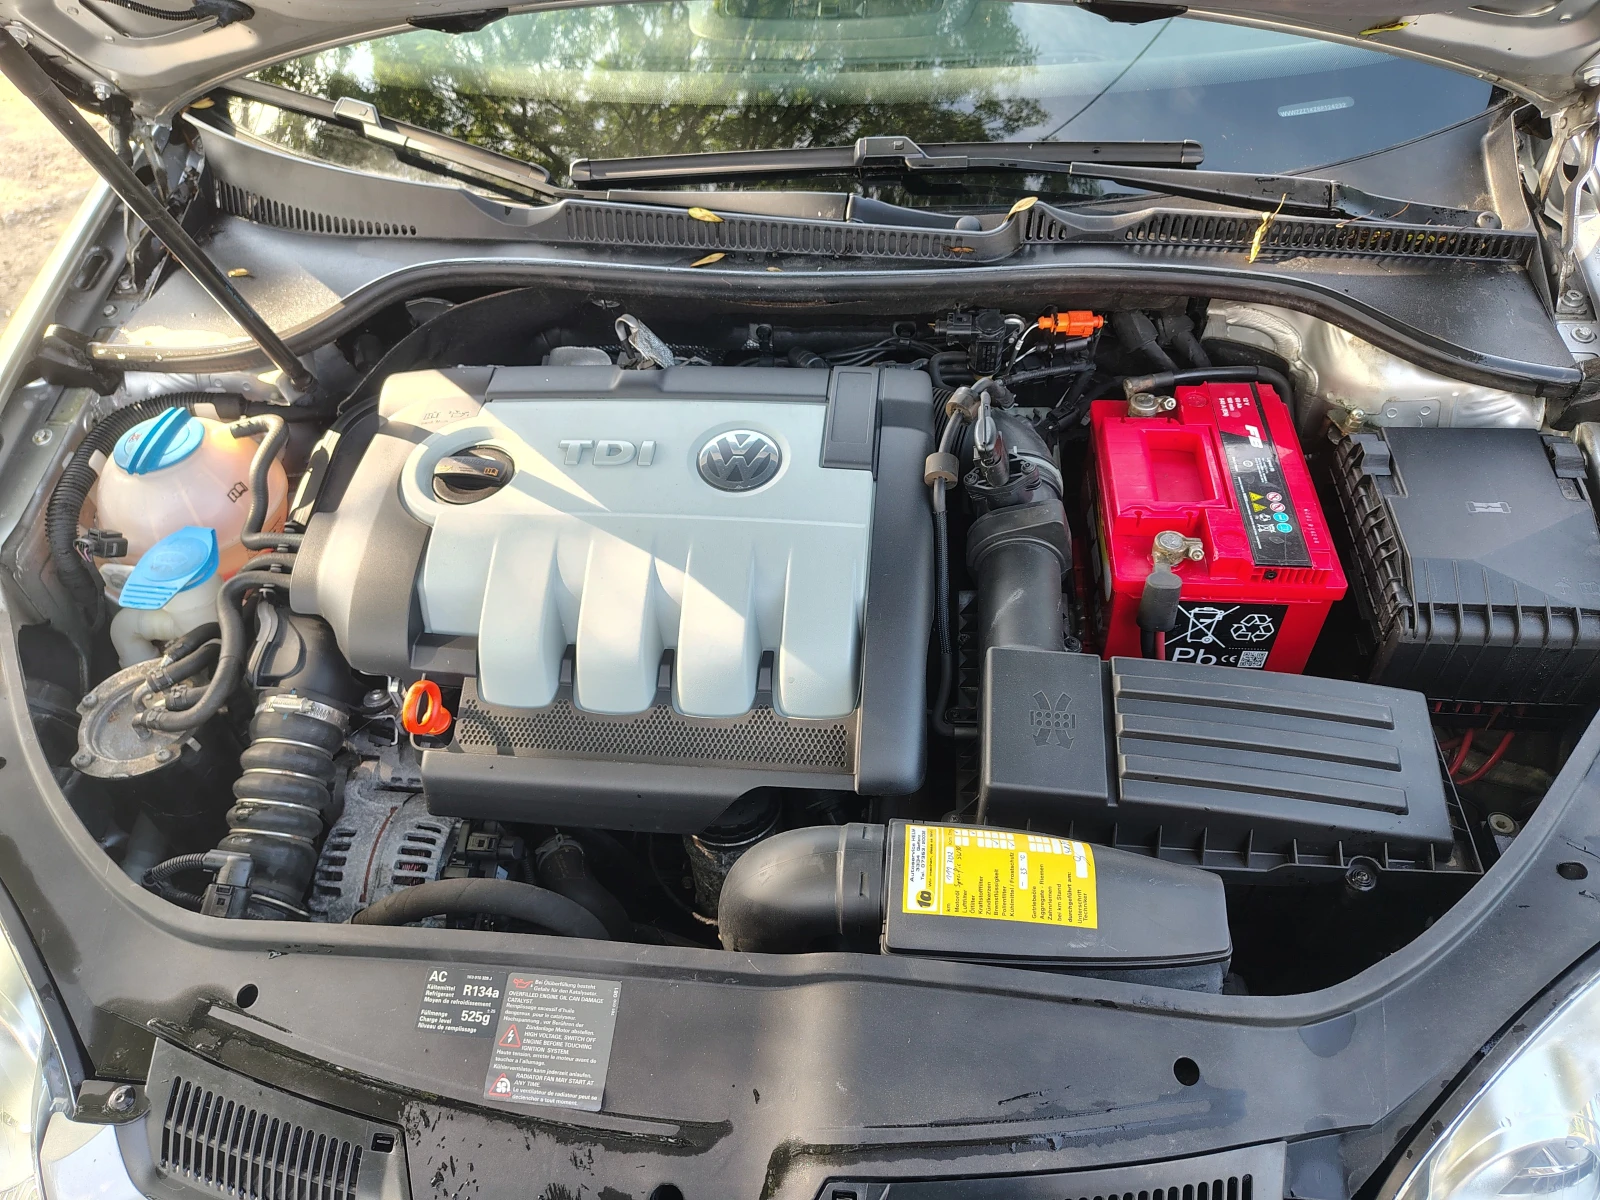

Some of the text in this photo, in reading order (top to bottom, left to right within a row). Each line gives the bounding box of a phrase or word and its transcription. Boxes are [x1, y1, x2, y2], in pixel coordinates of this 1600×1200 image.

[557, 438, 658, 466] TDI
[1172, 648, 1218, 666] Pb
[1057, 902, 1062, 911] km
[429, 971, 448, 982] AC
[463, 984, 499, 998] R134a
[451, 999, 491, 1007] refroidissement
[506, 1003, 537, 1011] Remplissage
[421, 1009, 448, 1018] Füllmenge
[461, 1010, 490, 1026] 525g
[445, 1026, 477, 1034] remplissage
[493, 1064, 533, 1072] Kühlerventilator
